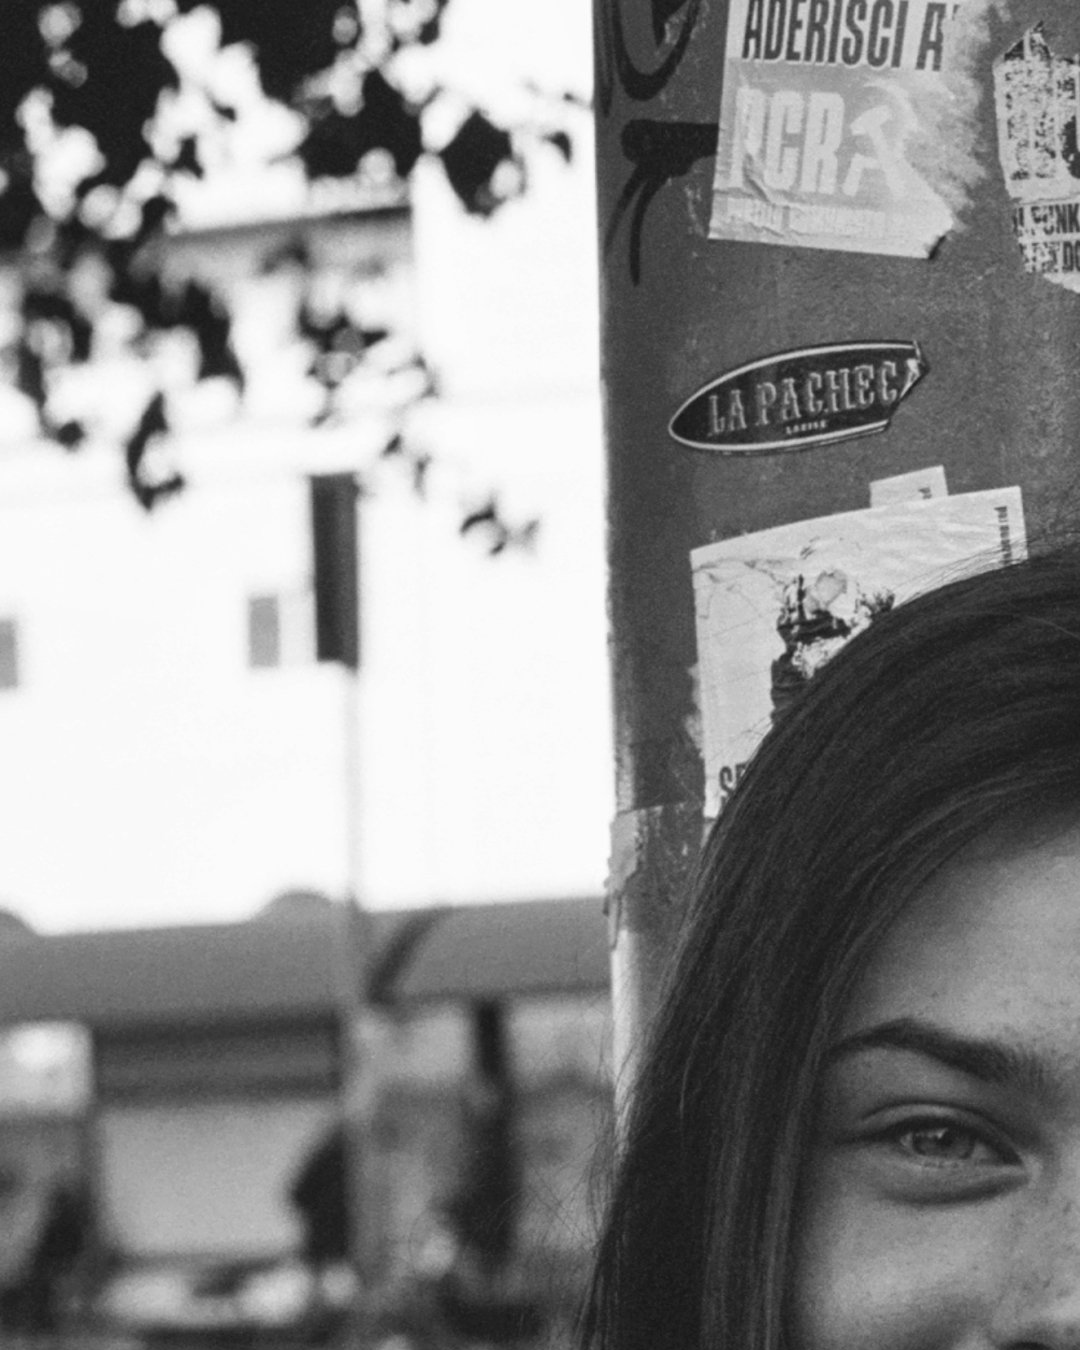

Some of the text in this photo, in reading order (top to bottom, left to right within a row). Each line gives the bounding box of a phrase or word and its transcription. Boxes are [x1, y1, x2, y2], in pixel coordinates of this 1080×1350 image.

[742, 0, 957, 71] ADERISCI A
[708, 359, 919, 437] LA PACHEC
